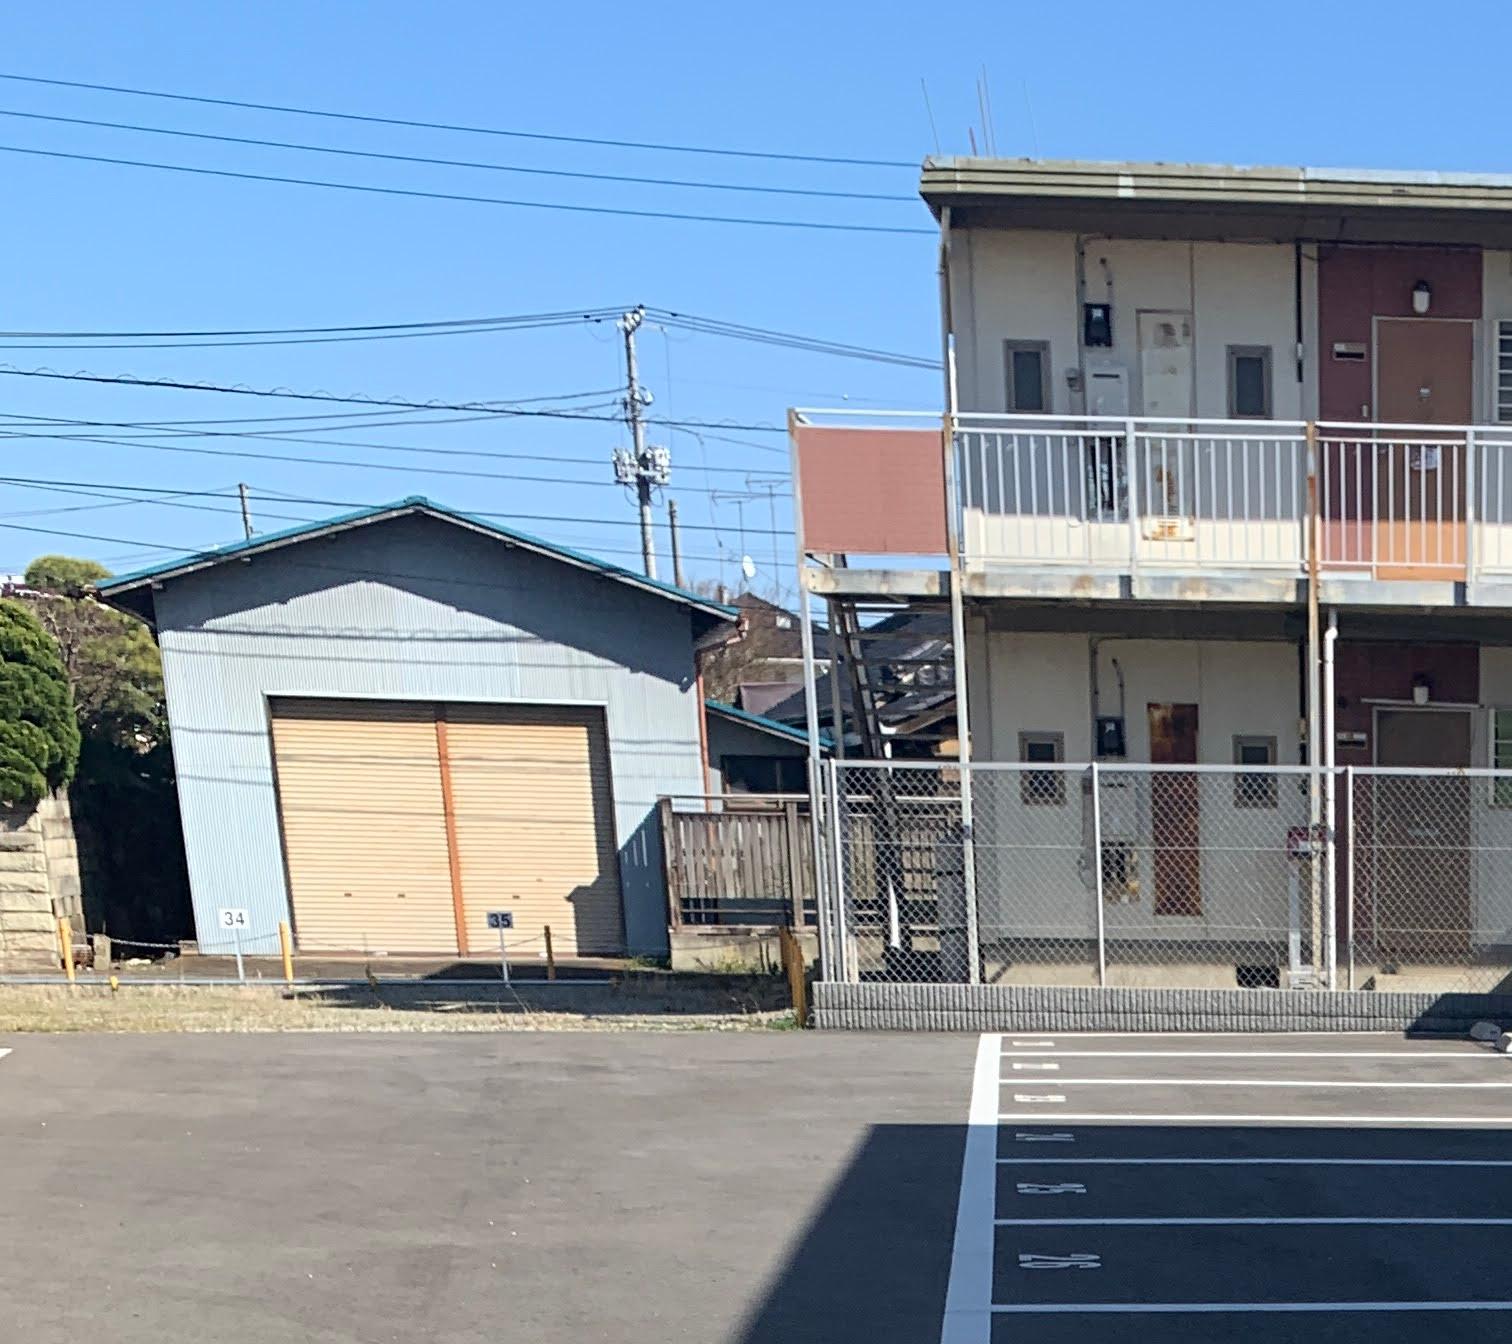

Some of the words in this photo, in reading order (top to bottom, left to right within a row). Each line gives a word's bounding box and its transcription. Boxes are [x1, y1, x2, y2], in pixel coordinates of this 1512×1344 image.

[224, 911, 245, 926] 34
[489, 912, 511, 928] 35
[1017, 1183, 1087, 1194] 25
[1018, 1253, 1101, 1269] 26
